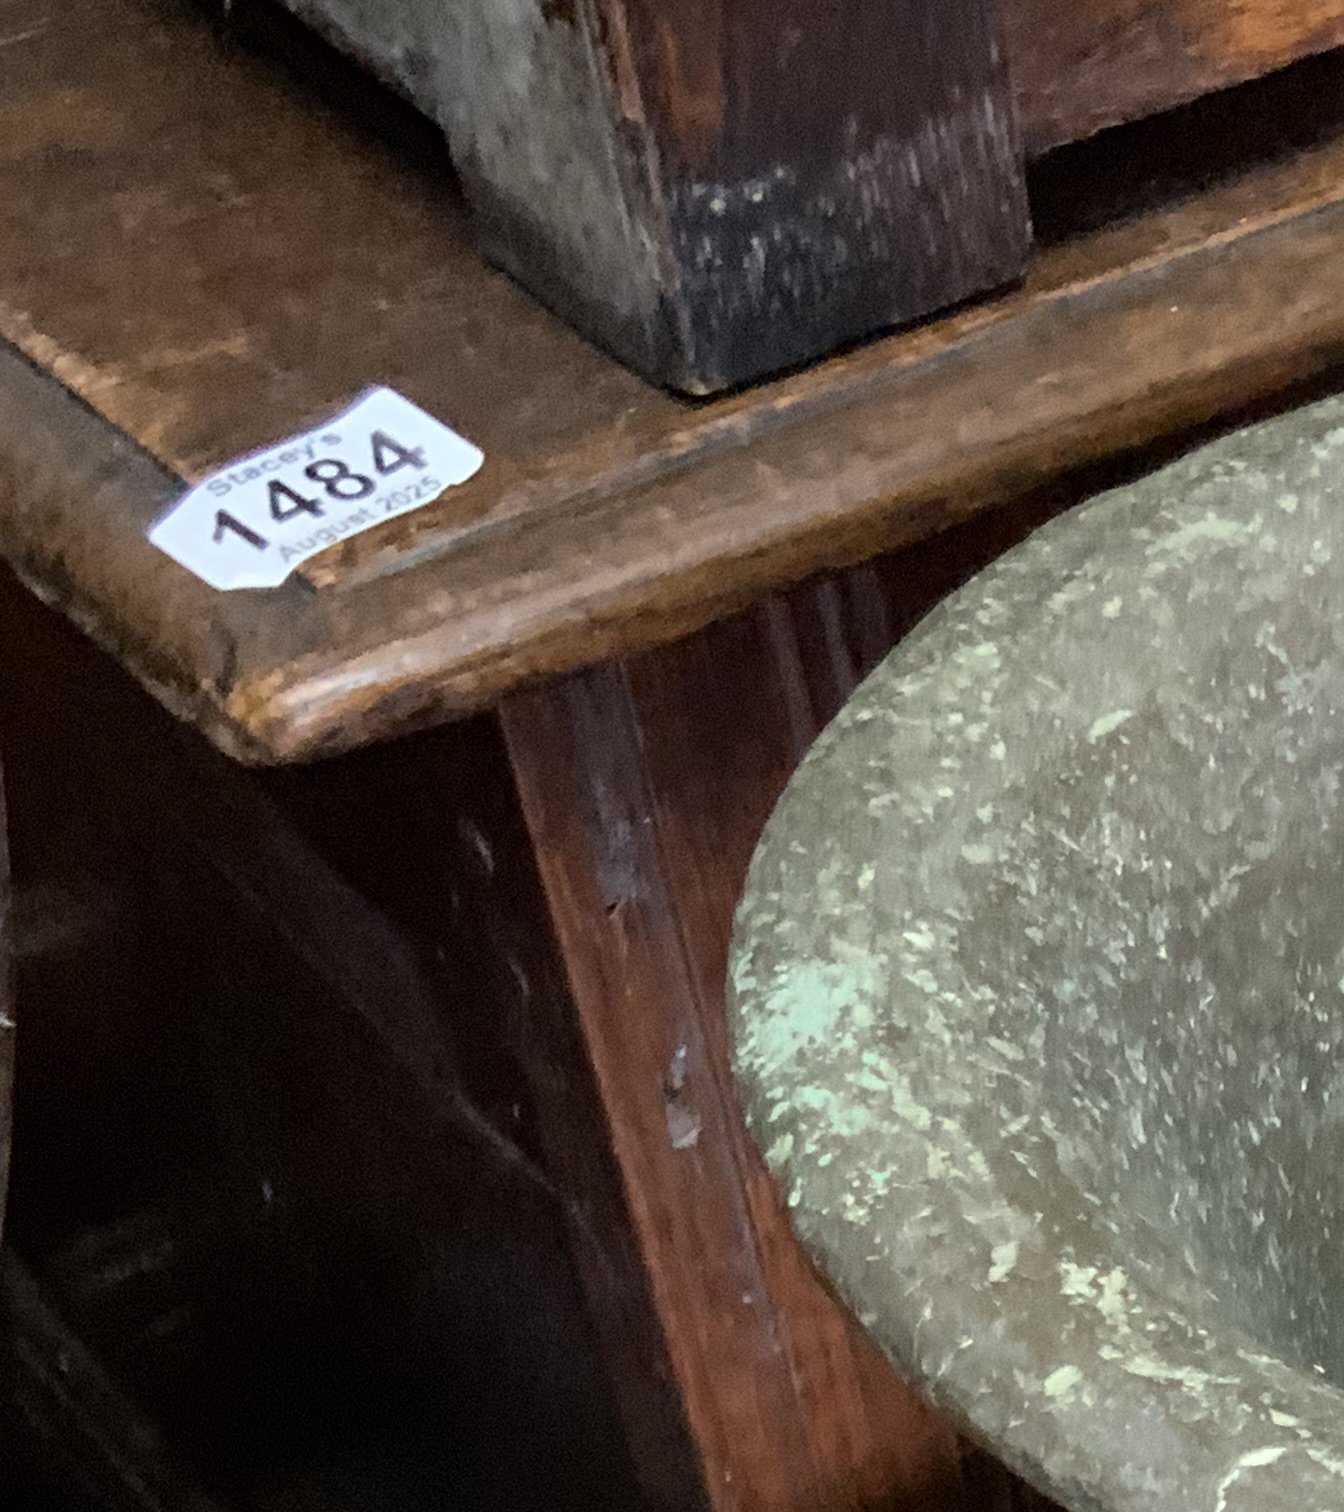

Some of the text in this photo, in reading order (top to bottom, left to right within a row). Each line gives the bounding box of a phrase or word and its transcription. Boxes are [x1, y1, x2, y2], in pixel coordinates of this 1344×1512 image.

[207, 433, 342, 497] Stacey's
[212, 429, 428, 551] 1484
[279, 475, 441, 562] August 2025
